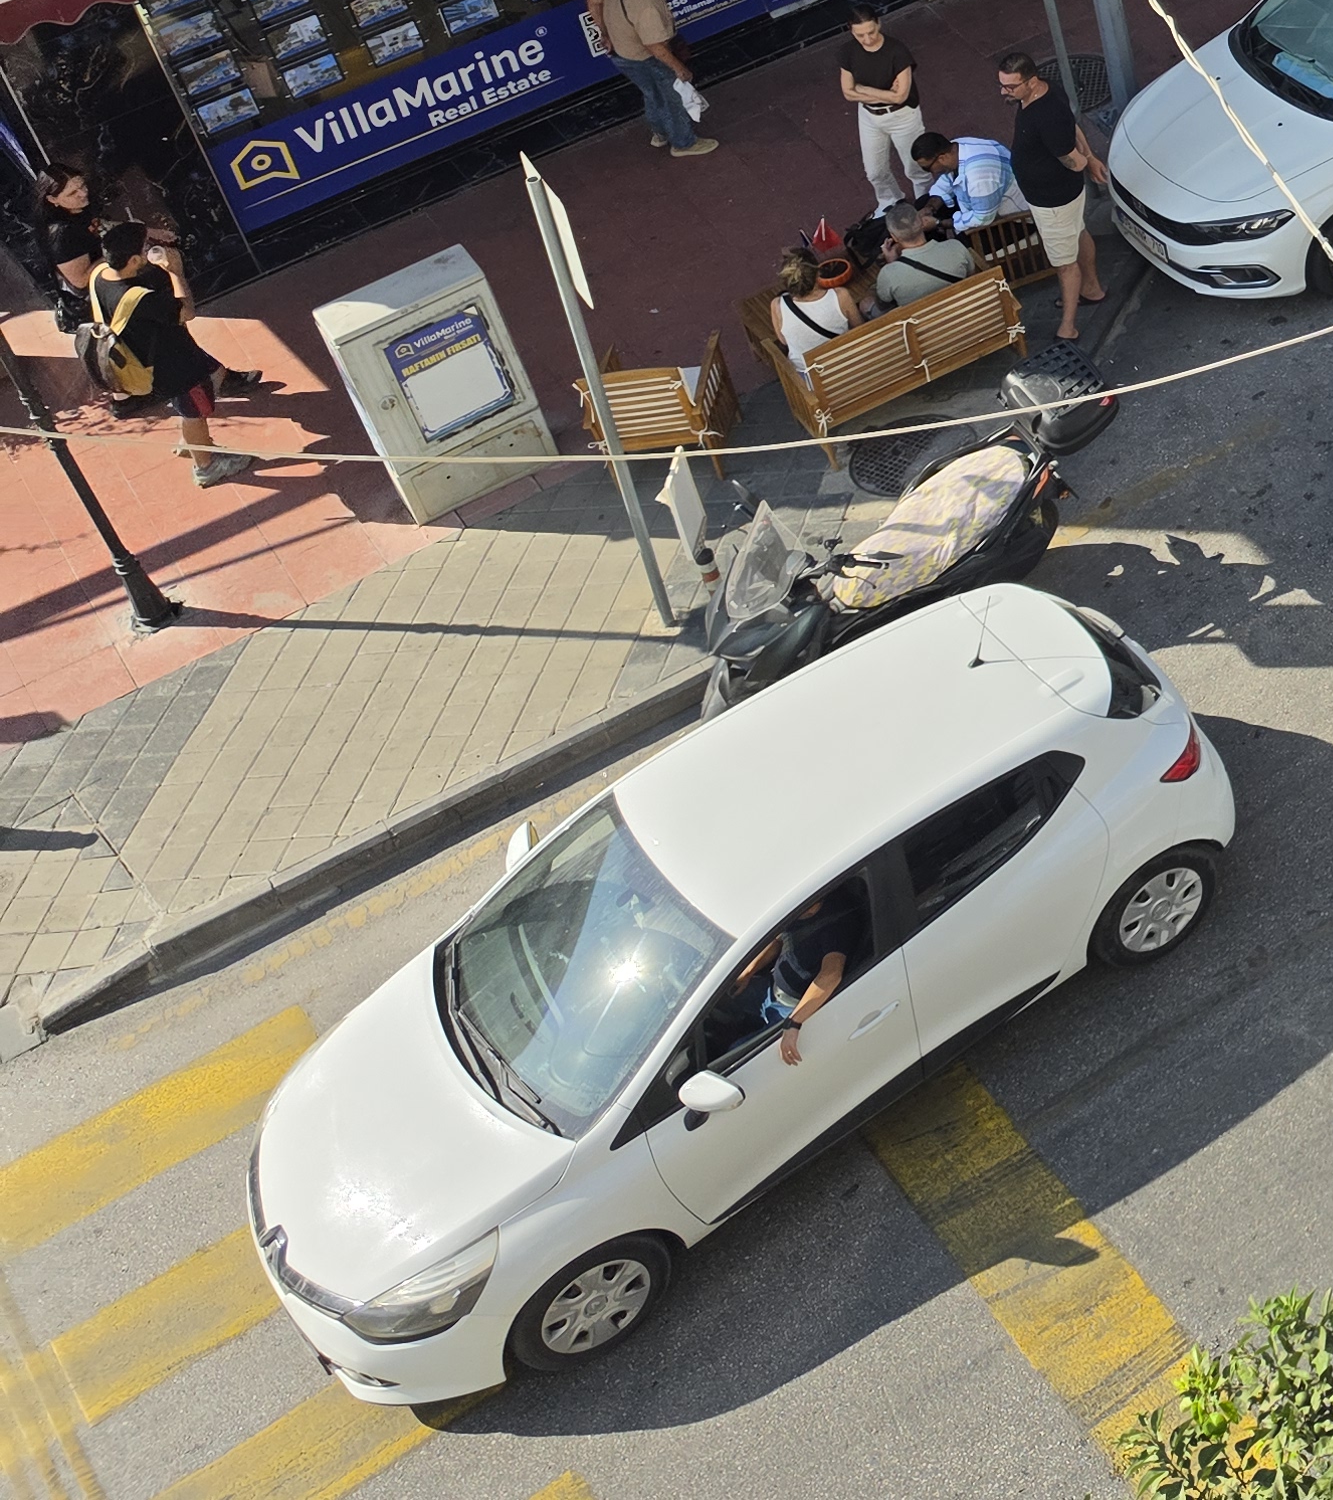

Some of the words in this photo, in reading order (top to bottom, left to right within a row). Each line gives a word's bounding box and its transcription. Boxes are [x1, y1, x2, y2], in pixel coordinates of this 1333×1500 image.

[294, 38, 546, 153] VillaMarine
[428, 96, 479, 129] Real
[482, 67, 552, 107] Estate
[402, 350, 447, 378] HAFTANIN
[446, 334, 481, 358] FIRSATI
[413, 316, 472, 349] VillaMarine
